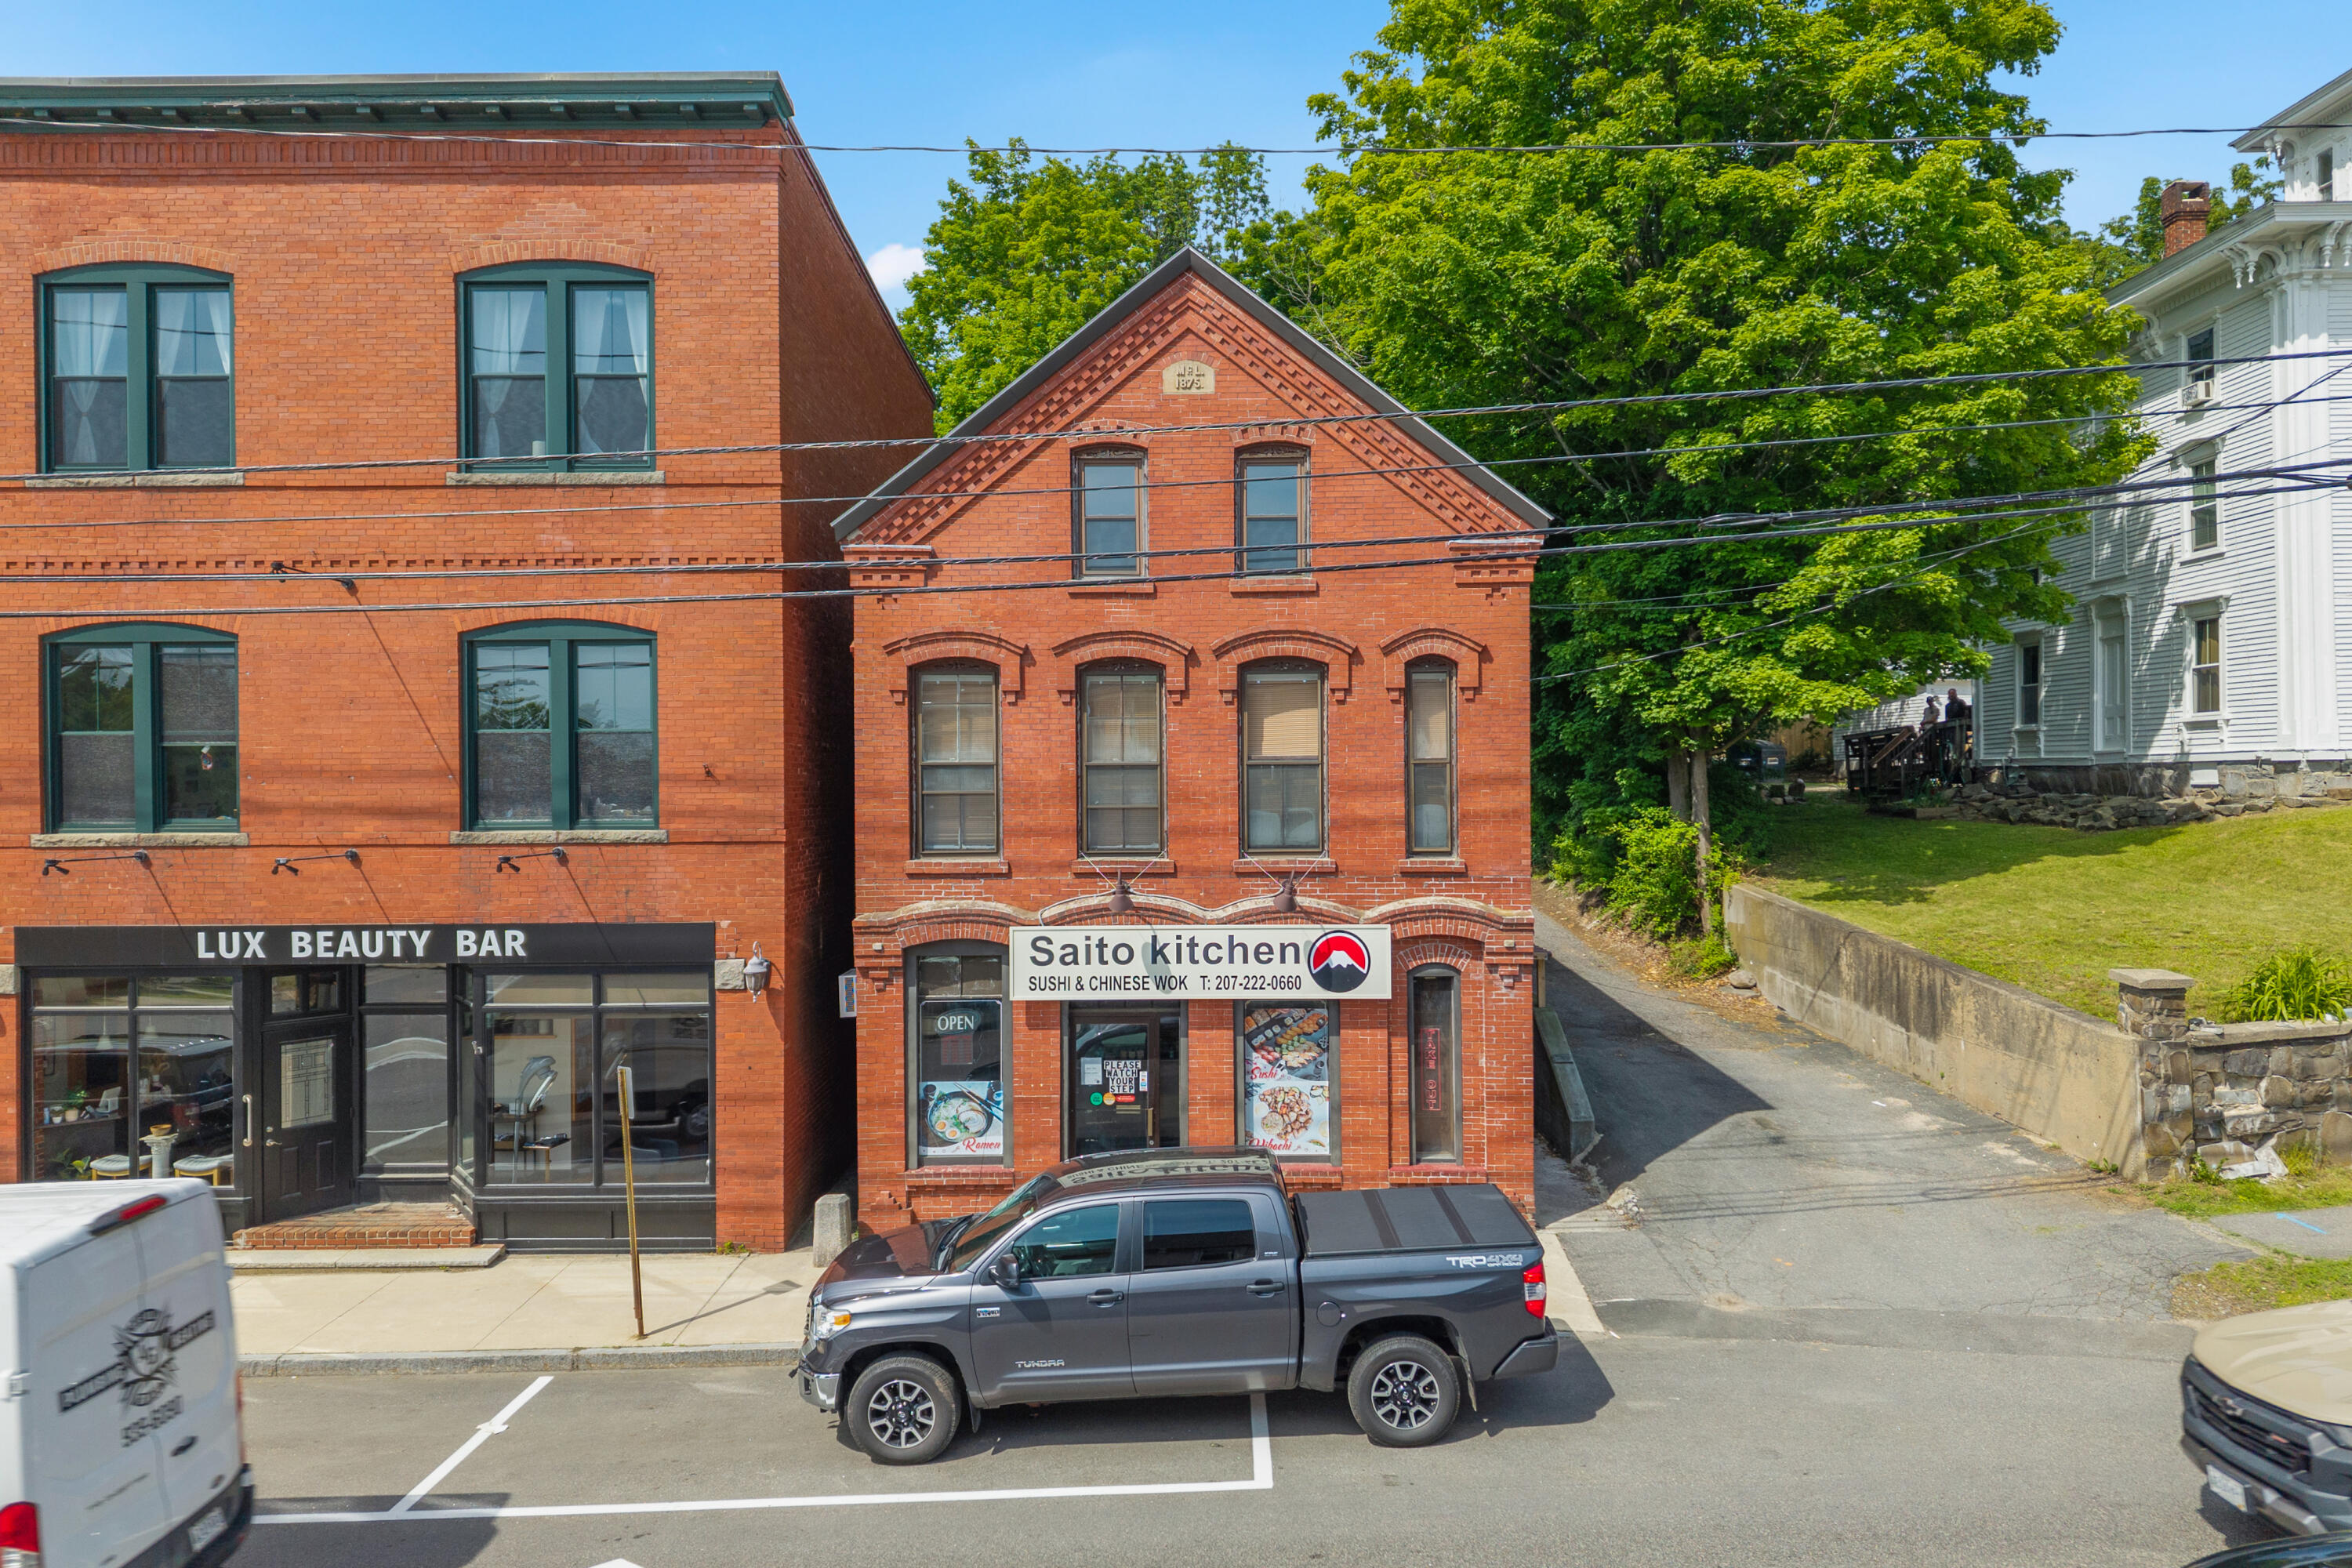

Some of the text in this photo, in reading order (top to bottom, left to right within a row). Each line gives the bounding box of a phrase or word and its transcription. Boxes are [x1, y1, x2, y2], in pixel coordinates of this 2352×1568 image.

[197, 930, 527, 959] LUX BEAUTY BAR
[1029, 935, 1301, 966] Saito kitchen
[1029, 975, 1301, 991] SUSHI & CHINESE WOK T: 207-222-0660
[937, 1015, 975, 1030] OPEN
[1105, 1061, 1140, 1069] PLEASE
[1425, 1029, 1436, 1109] TAKE OUT
[1250, 1066, 1278, 1080] Sushi
[962, 1136, 1000, 1152] Ramen
[1446, 1255, 1487, 1268] TRD
[1014, 1359, 1065, 1368] TUNDRA
